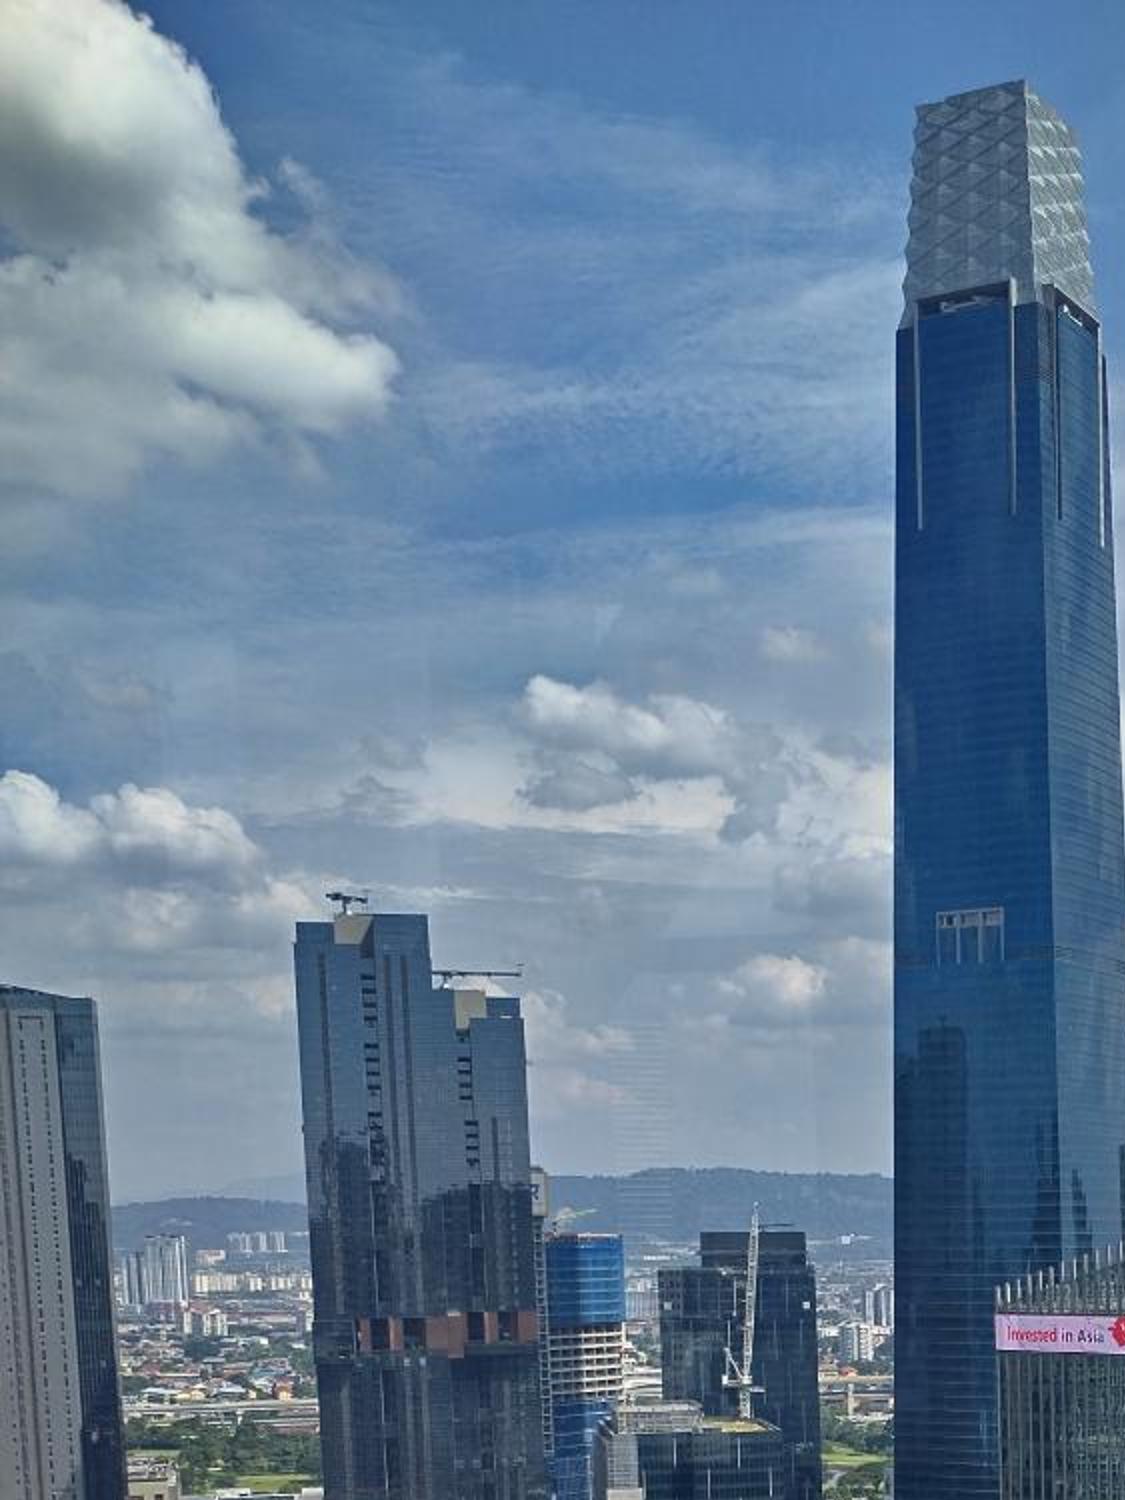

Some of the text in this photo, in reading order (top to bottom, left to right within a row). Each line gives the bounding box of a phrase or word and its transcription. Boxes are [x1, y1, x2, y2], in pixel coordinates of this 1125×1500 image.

[1007, 1325, 1105, 1343] Invested in Asia
